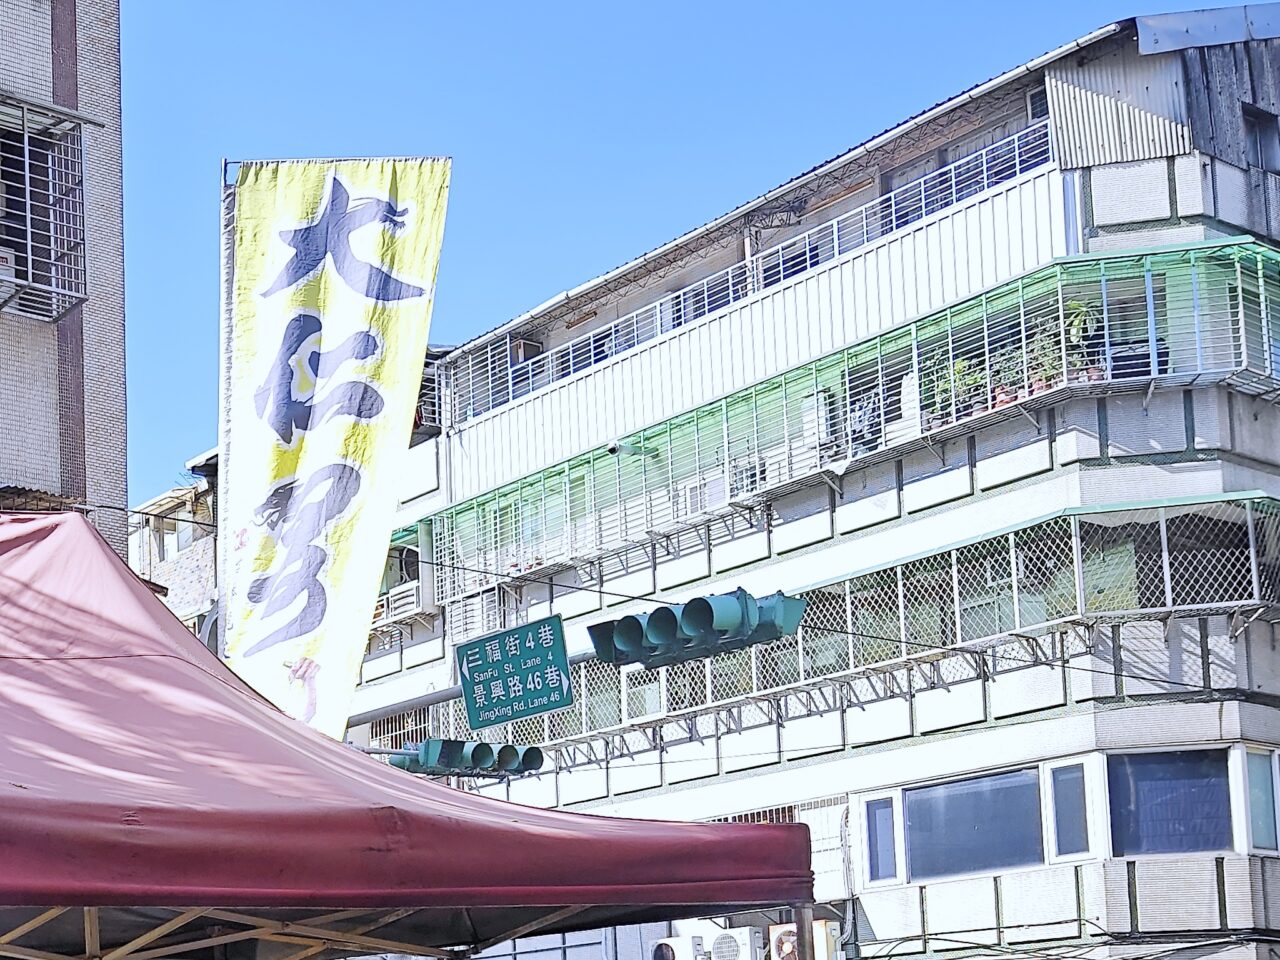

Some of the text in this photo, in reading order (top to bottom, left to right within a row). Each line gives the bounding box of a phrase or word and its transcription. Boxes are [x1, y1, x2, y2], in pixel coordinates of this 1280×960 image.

[467, 624, 554, 668] 三福街4巷
[473, 651, 553, 683] SanFu St. Lane 4
[473, 664, 561, 708] 景興路46巷
[478, 691, 560, 721] JingXing Rd. Lane 46
